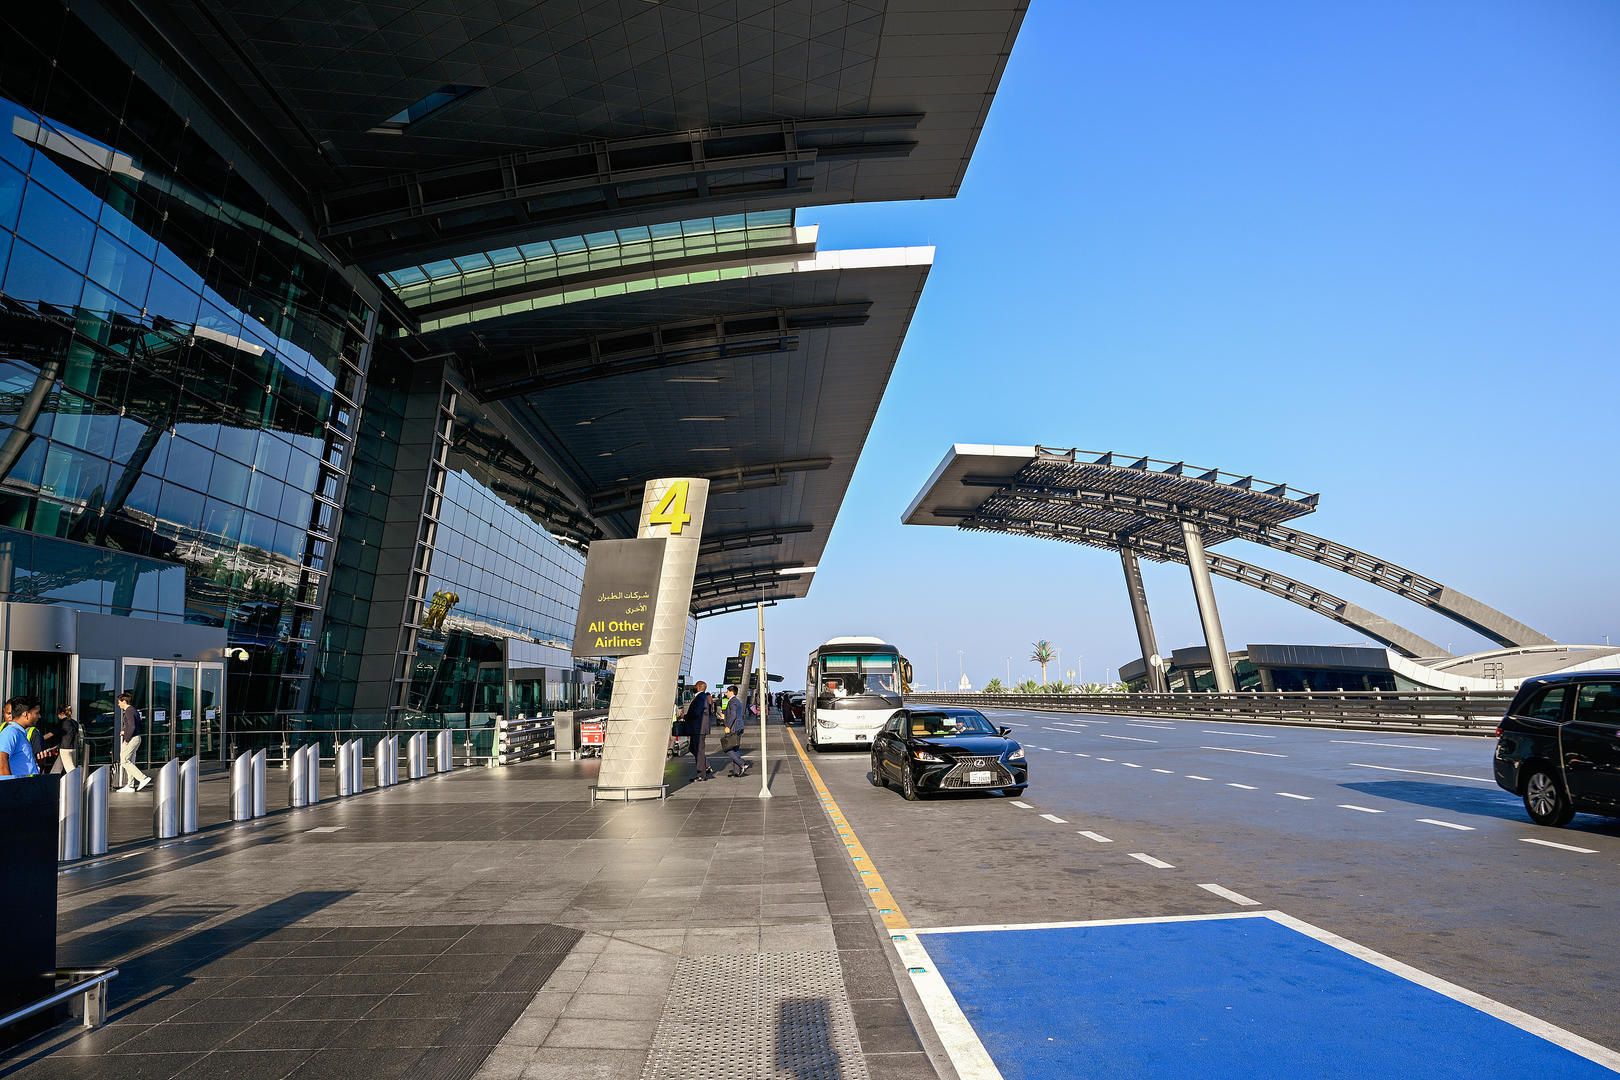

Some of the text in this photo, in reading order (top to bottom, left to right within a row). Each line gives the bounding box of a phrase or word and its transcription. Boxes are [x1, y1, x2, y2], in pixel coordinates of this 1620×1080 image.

[650, 481, 691, 534] 4
[598, 592, 650, 602] شركات الطيران
[625, 603, 647, 614] الأخرى
[589, 620, 645, 632] All Other
[595, 636, 642, 648] Airlines
[741, 643, 752, 656] 3
